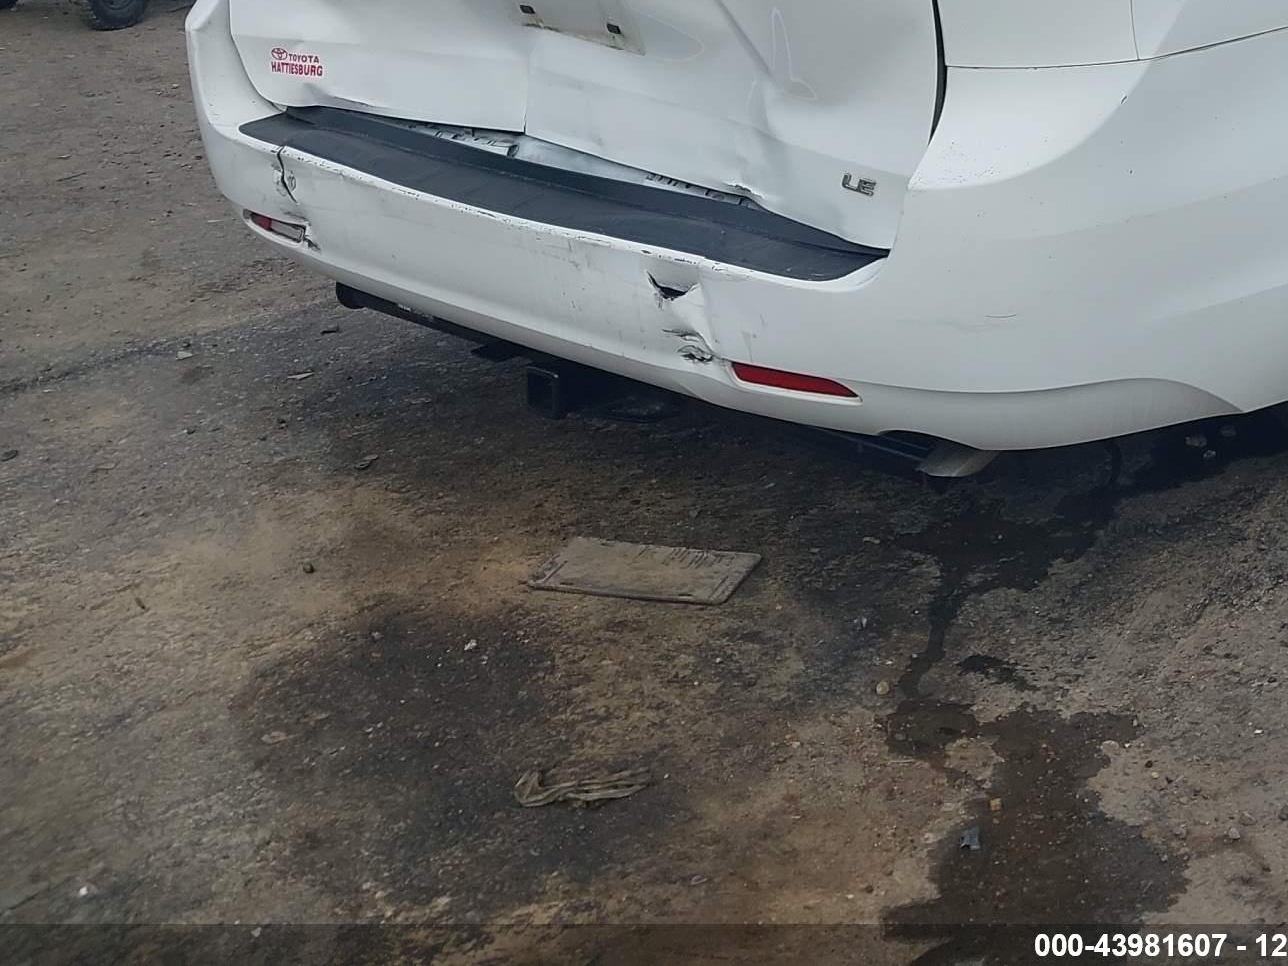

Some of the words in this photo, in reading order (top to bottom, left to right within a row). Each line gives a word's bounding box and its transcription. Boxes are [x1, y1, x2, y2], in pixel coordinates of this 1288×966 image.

[289, 53, 320, 64] TOYOTA
[271, 61, 323, 77] HATTIESBURG
[842, 173, 876, 197] LE
